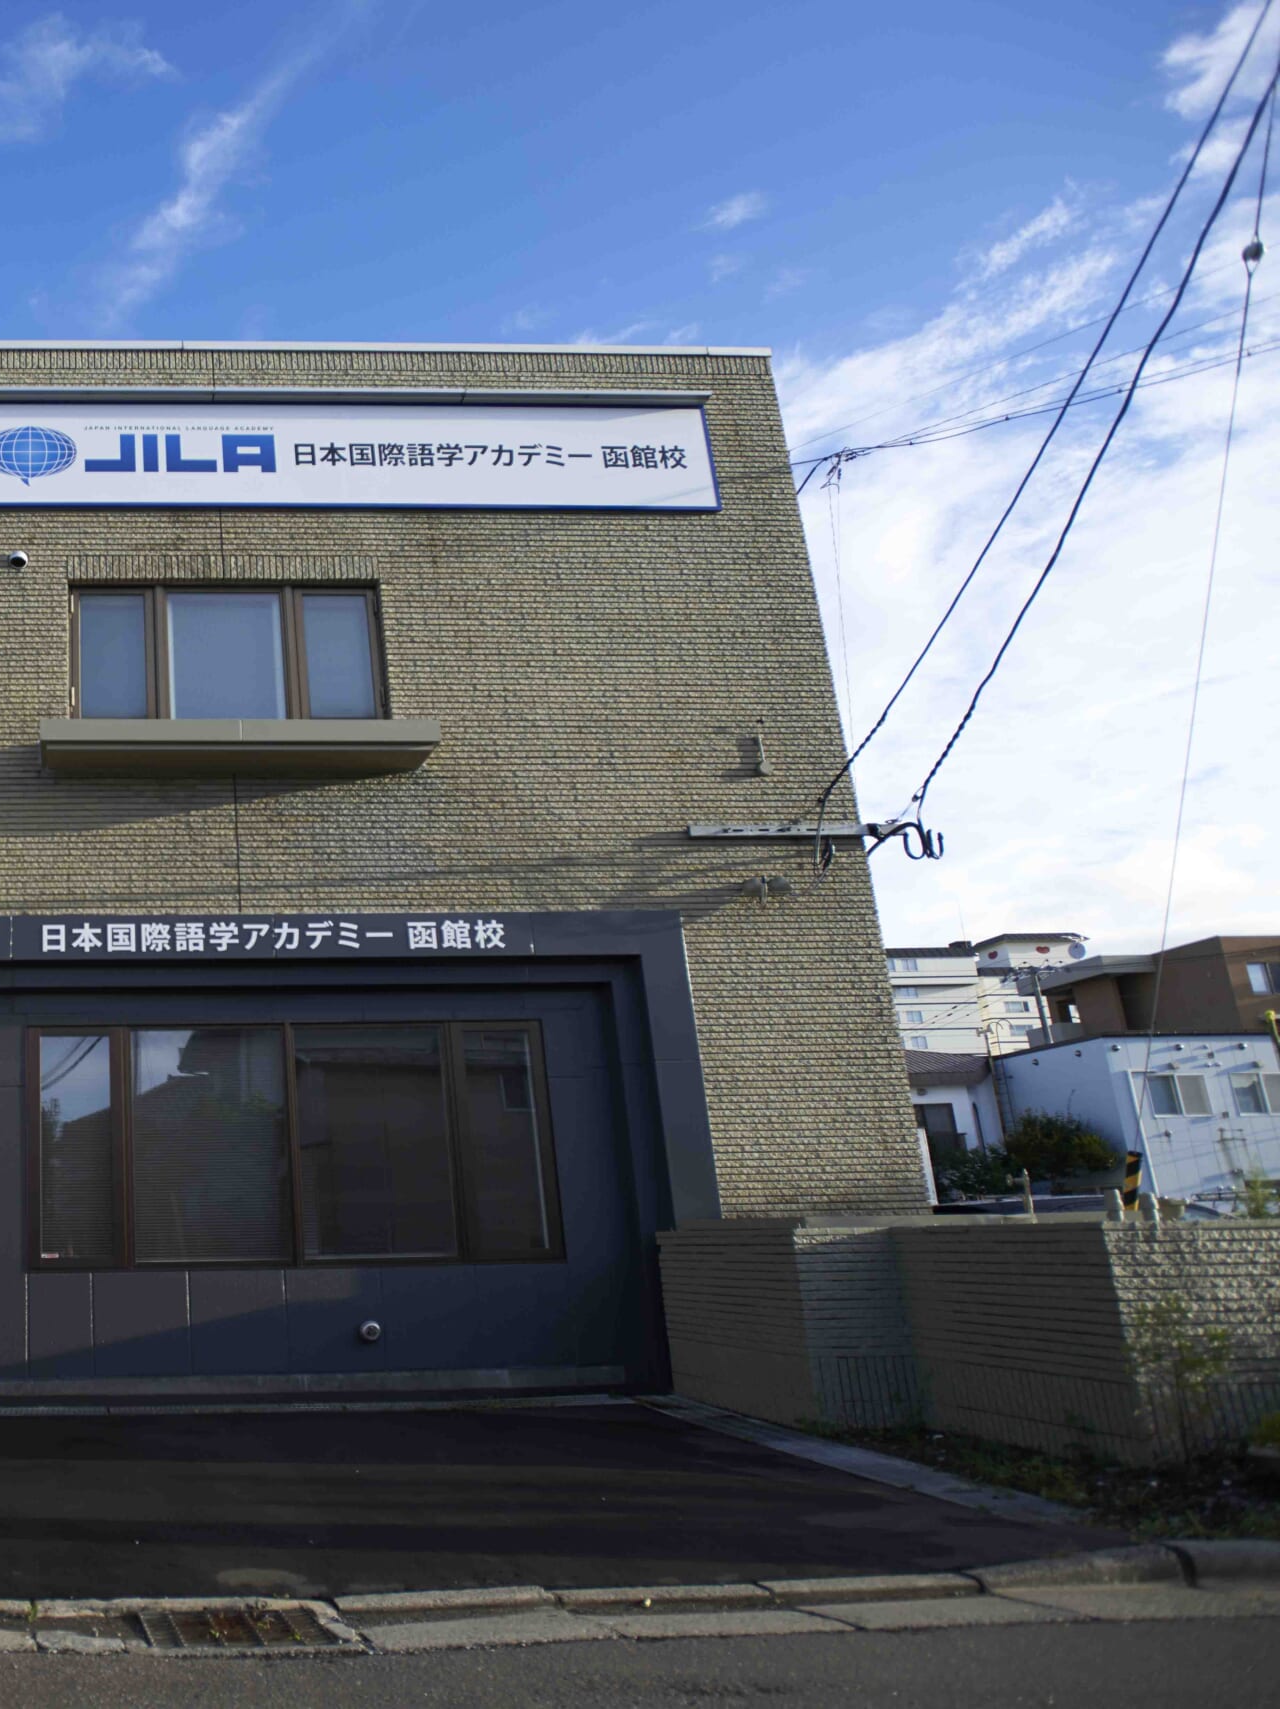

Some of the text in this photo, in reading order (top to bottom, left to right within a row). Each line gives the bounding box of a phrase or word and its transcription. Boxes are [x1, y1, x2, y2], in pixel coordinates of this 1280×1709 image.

[84, 433, 277, 473] JILA
[293, 442, 688, 469] 日本国際語学アカデミー 函館校
[40, 920, 507, 953] 日本国際語学アカデミー 函館校
